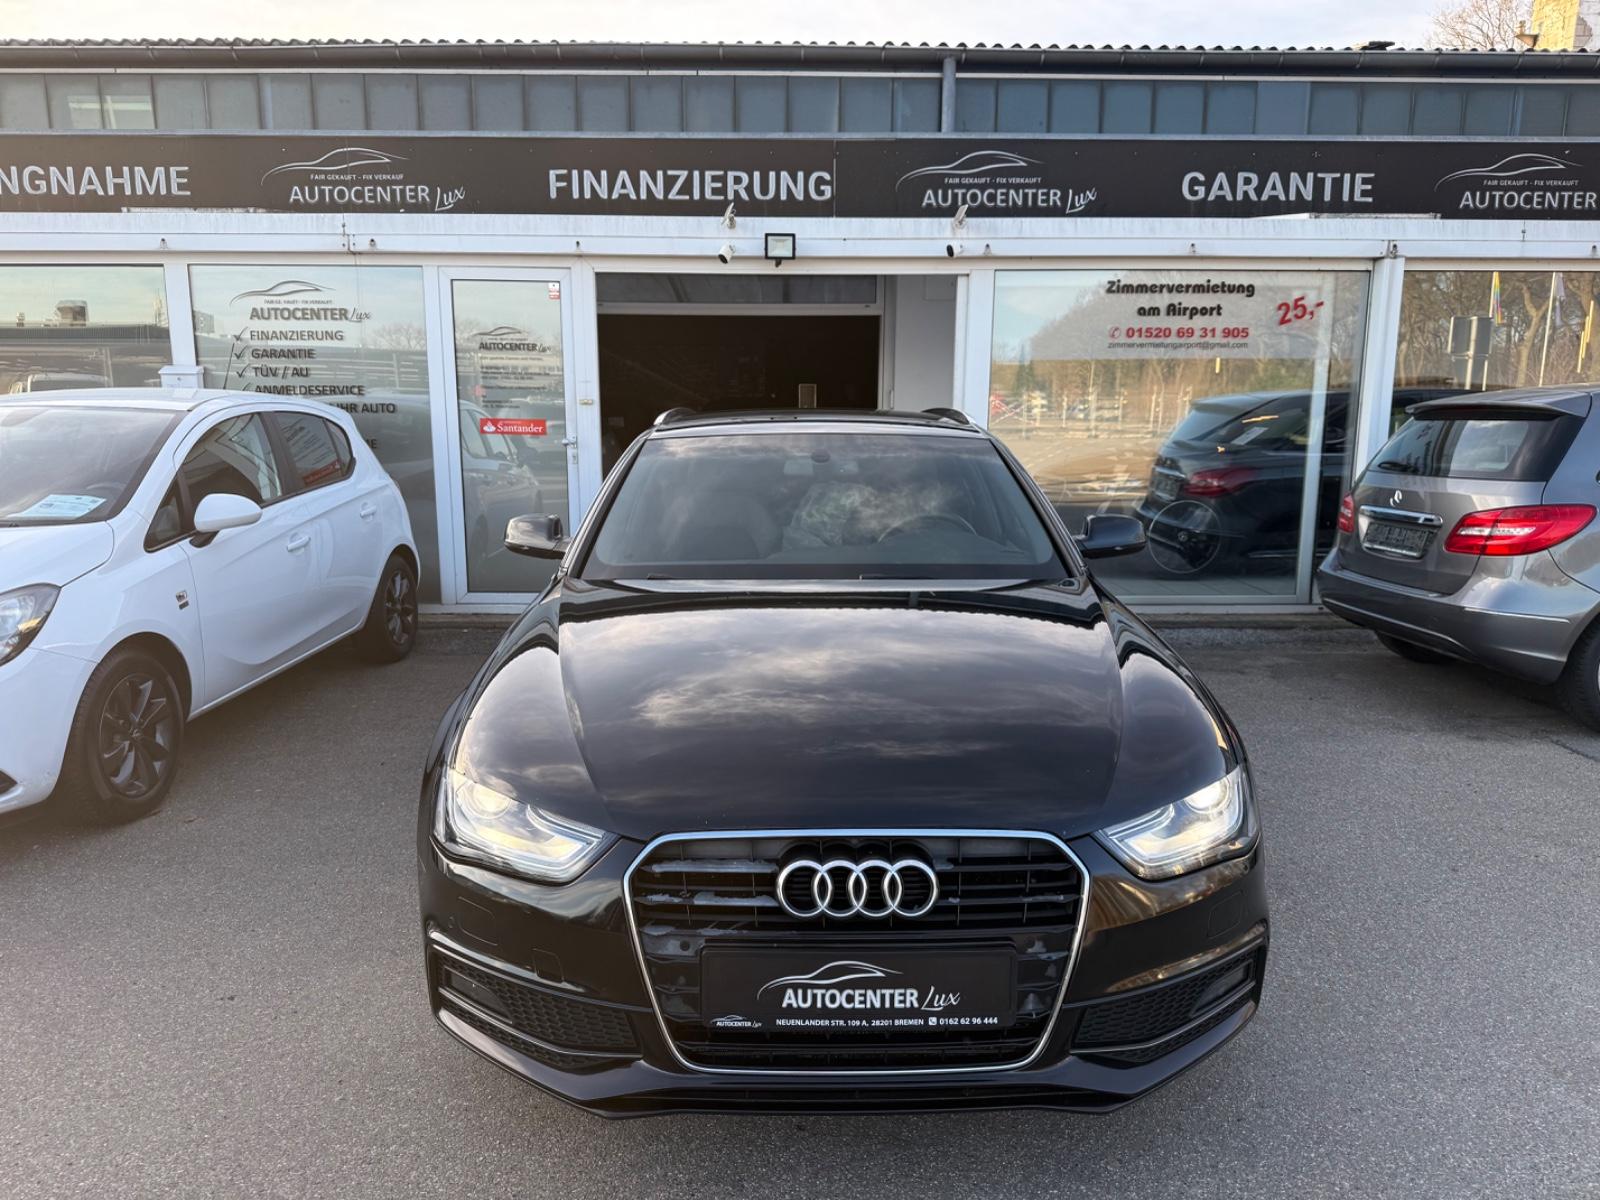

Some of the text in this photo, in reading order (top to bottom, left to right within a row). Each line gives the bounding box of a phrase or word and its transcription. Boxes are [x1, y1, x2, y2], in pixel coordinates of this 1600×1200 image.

[0, 165, 192, 196] NGNAHME
[310, 173, 326, 181] FAIR
[326, 173, 357, 181] GEKAUFT
[362, 173, 374, 181] FIX
[548, 168, 833, 201] FINANZIERUNG
[1181, 171, 1376, 203] GARANTIE
[289, 185, 466, 212] AUTOCENTER Lux
[921, 187, 1098, 215] AUTOCENTER Lux
[1459, 191, 1597, 209] AUTOCENTER
[1105, 279, 1256, 298] Zimmervermietung
[249, 307, 371, 323] AUTOCENTER Lux
[1136, 302, 1223, 320] am Airport
[1276, 295, 1324, 326] 25,-
[249, 330, 344, 341] FINANZIERUNG
[1125, 326, 1249, 338] 01520 69 31 905
[251, 348, 316, 359] GARANTIE
[479, 342, 538, 352] AUTOCENTER
[253, 364, 278, 377] TÜV
[291, 366, 310, 377] AU
[254, 384, 365, 396] ANMELDESERVICE
[361, 402, 396, 414] AUTO
[497, 421, 545, 433] Santander
[781, 985, 961, 1011] AUTOCENTER Lux
[939, 1017, 959, 1025] 0162
[960, 1017, 970, 1025] 62
[972, 1017, 982, 1025] 96
[983, 1017, 998, 1025] 444
